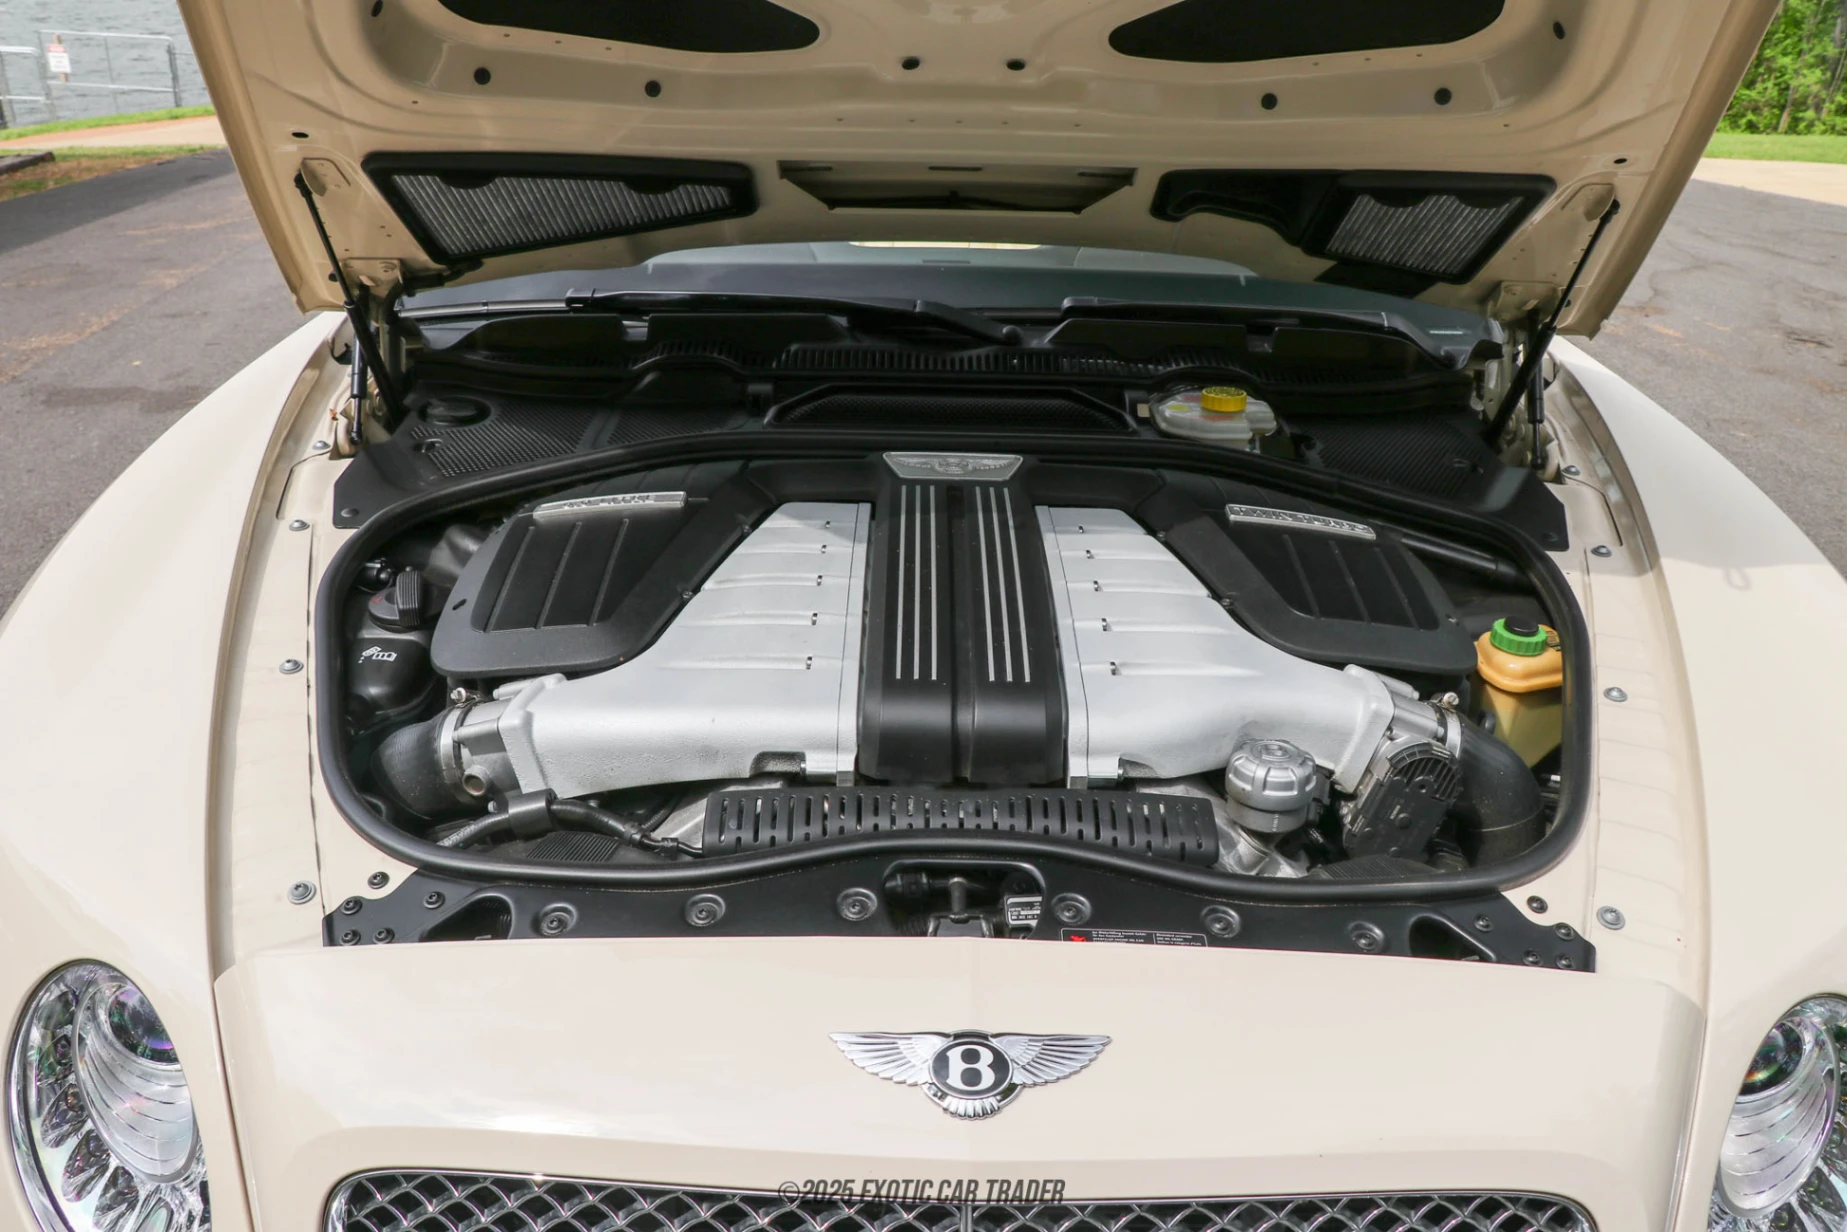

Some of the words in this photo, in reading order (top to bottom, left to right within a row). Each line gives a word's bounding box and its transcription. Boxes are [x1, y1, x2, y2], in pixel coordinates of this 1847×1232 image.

[1233, 506, 1293, 521] TWIN
[1297, 514, 1368, 533] TURBO
[946, 1044, 996, 1091] B
